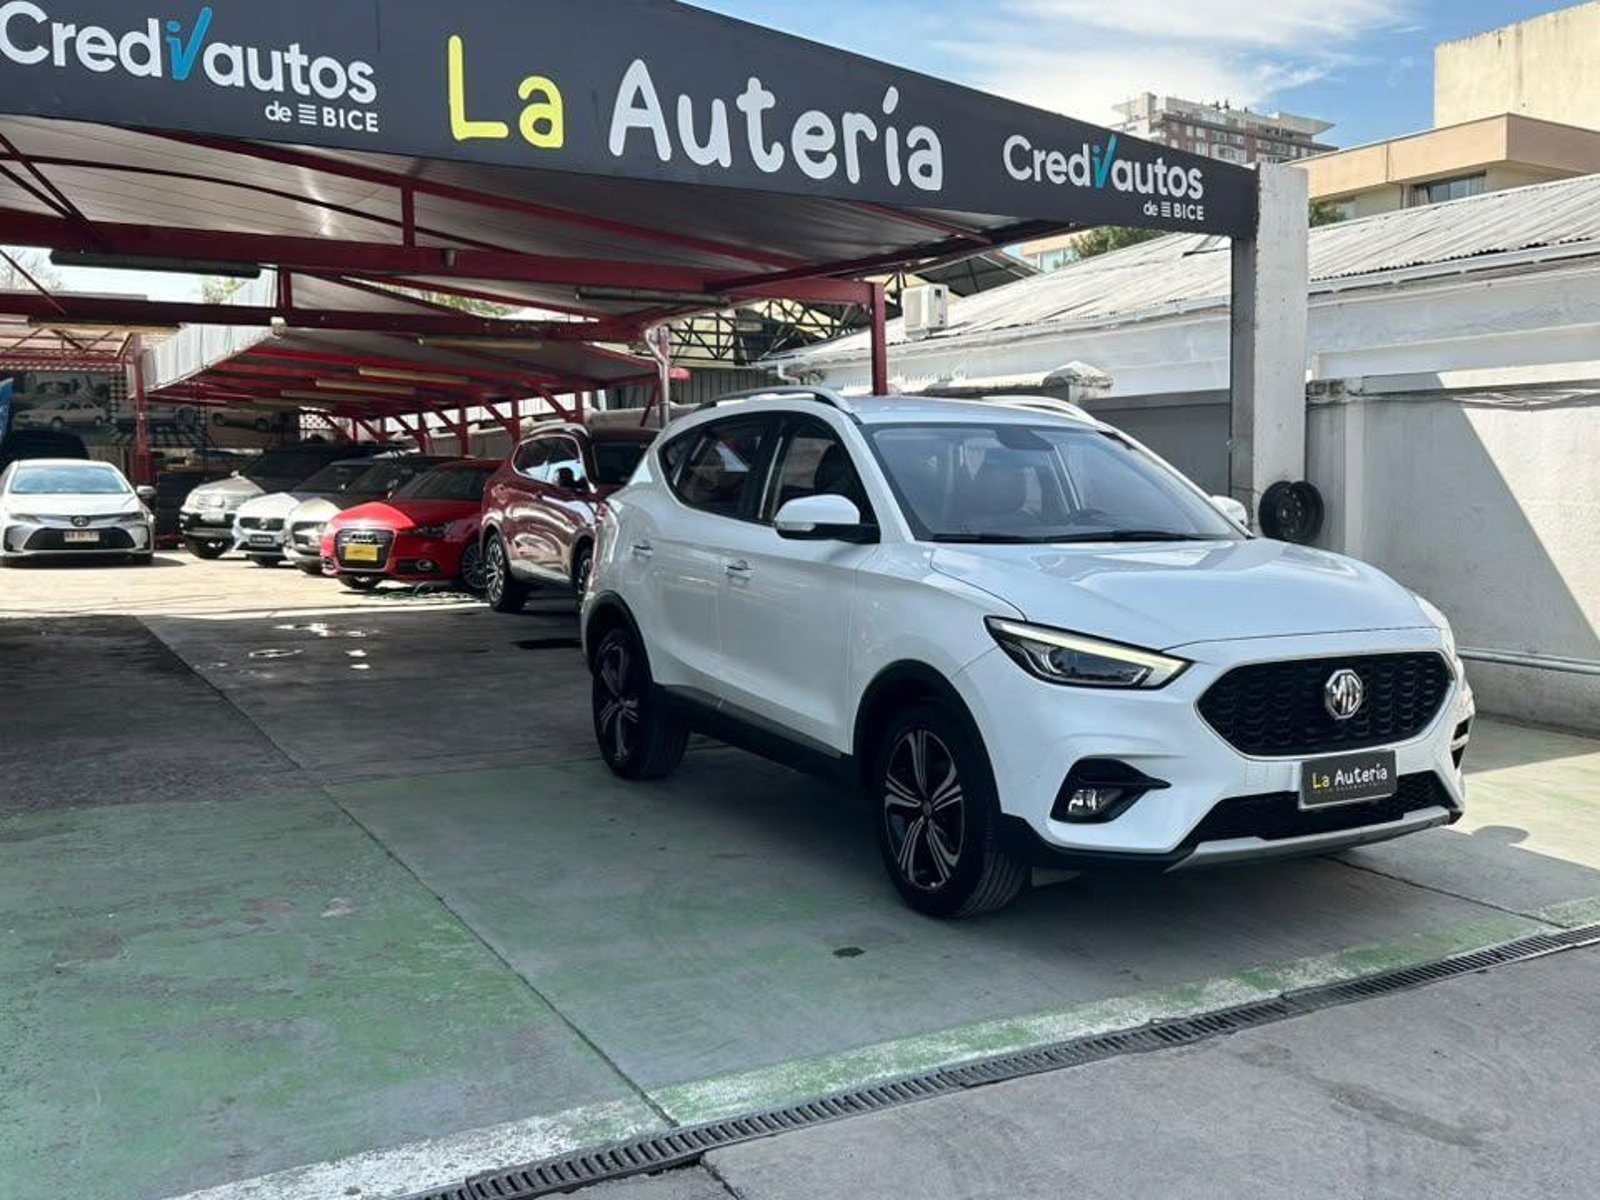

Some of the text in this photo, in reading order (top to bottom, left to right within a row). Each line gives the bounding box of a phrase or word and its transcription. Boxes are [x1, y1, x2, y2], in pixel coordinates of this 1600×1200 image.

[264, 100, 379, 133] de BICE
[448, 36, 944, 192] La Autería
[1142, 200, 1204, 221] de BICE
[1330, 672, 1361, 716] MG
[1312, 772, 1331, 790] La
